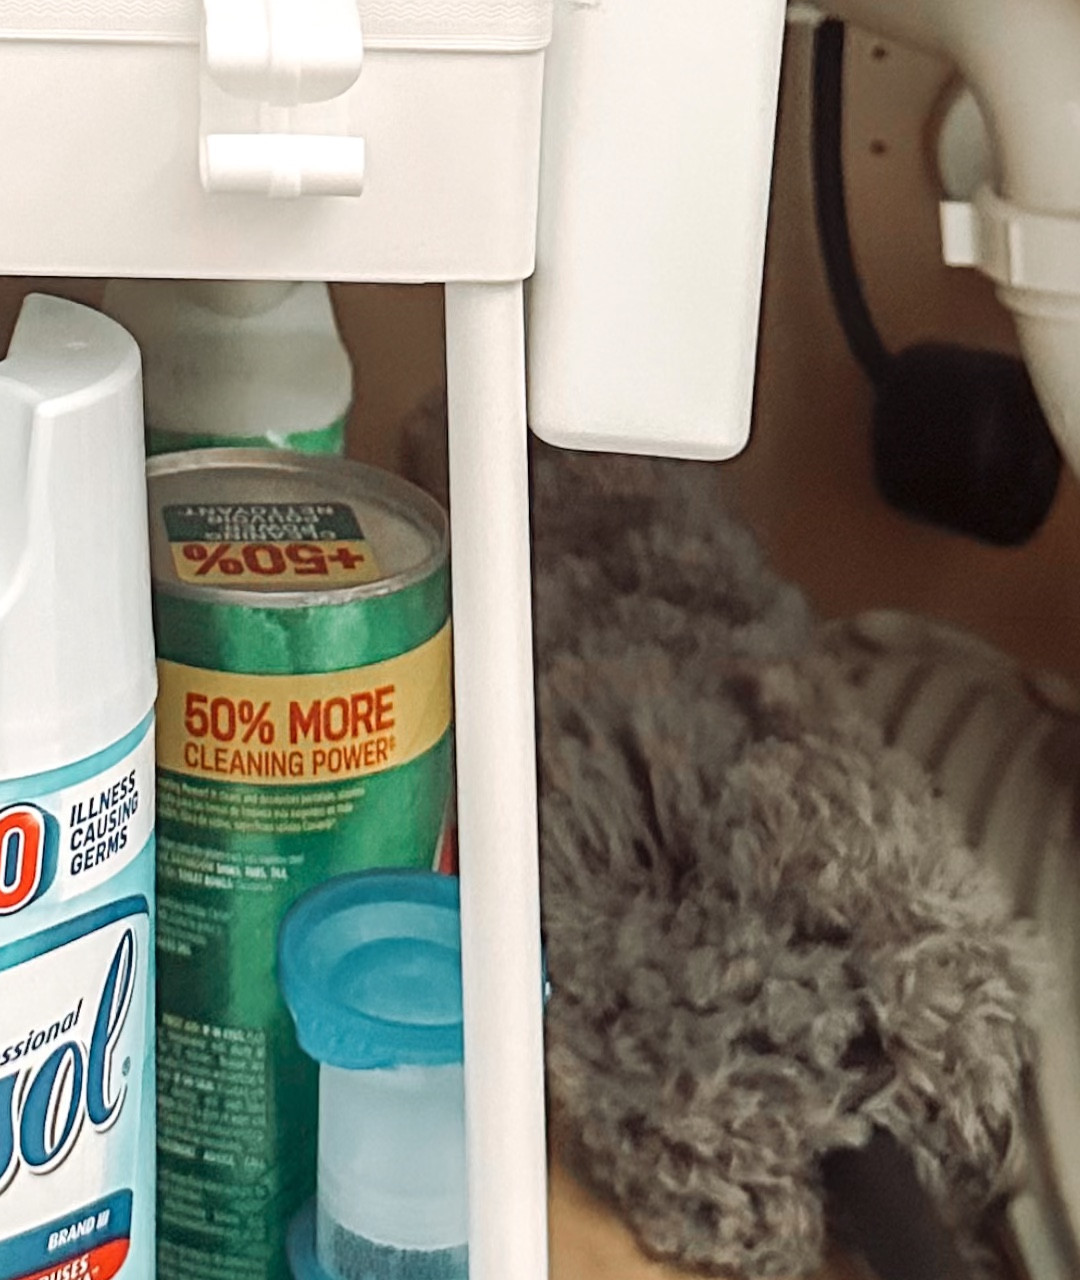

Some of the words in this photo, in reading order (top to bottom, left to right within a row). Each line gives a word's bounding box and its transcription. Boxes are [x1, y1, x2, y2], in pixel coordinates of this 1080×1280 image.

[182, 542, 365, 577] +50%
[184, 691, 274, 746] 50%
[288, 684, 396, 745] MORE
[184, 741, 303, 778] CLEANING
[69, 769, 137, 828] ILLNESS
[69, 790, 139, 852] CAUSING
[69, 827, 128, 876] GERMS
[47, 1219, 96, 1253] BRAND
